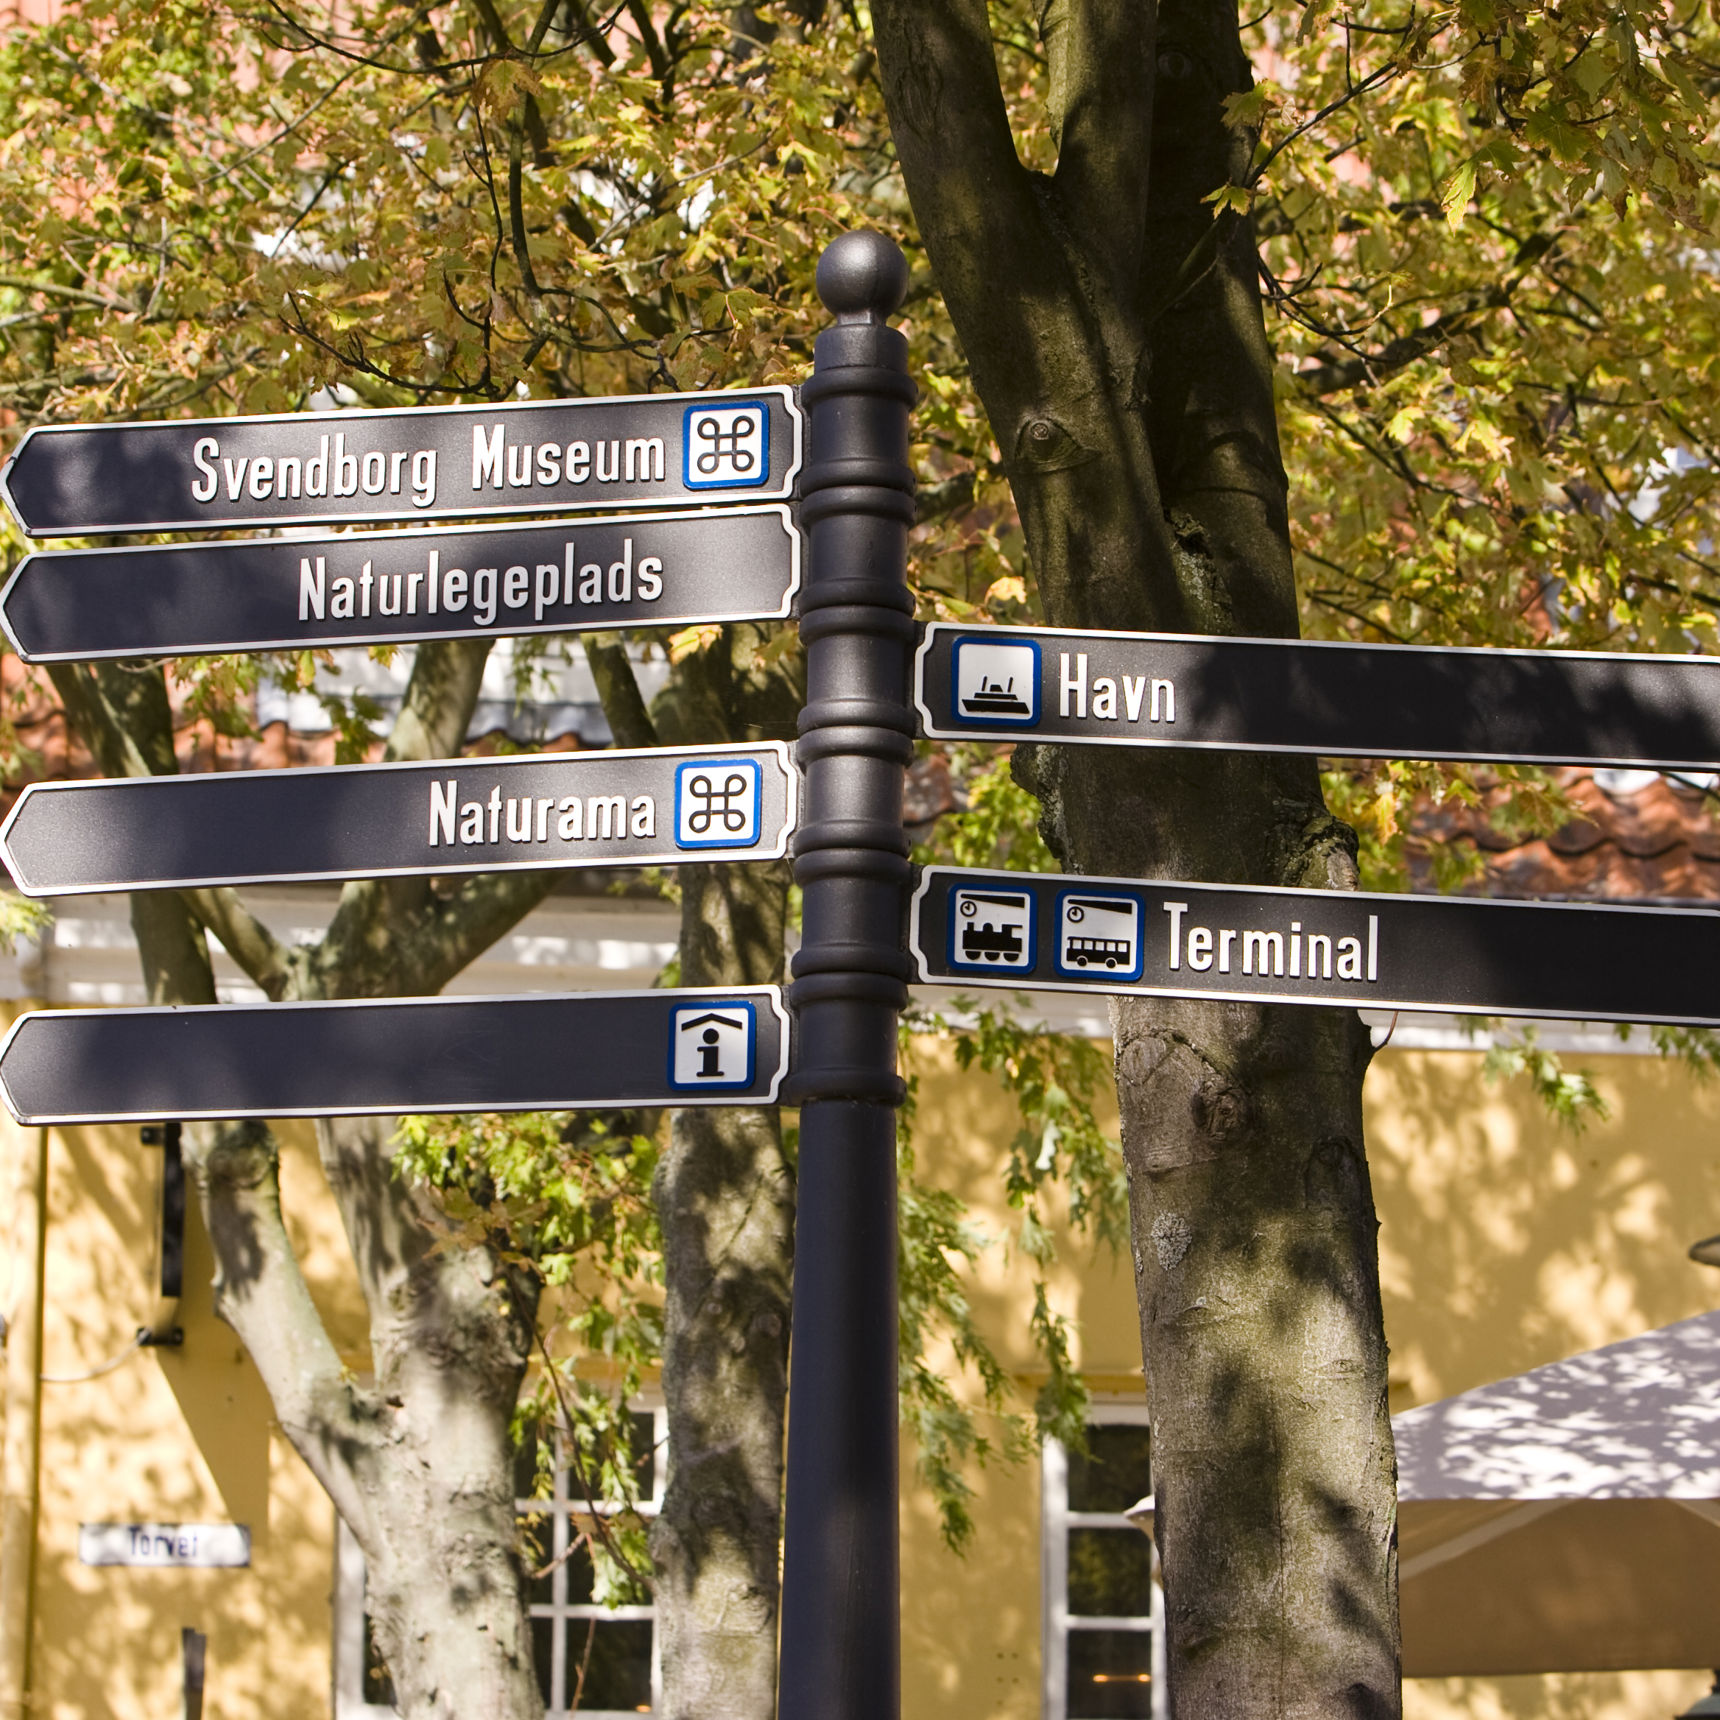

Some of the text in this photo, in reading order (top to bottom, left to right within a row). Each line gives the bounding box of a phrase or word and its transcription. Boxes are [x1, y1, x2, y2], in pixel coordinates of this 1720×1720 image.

[192, 423, 666, 508] Svendborg Museum
[298, 538, 664, 625] Naturlegeplads
[1058, 652, 1176, 723] Havn
[428, 780, 656, 848] Naturama
[1163, 902, 1379, 981] Terminal
[128, 1526, 198, 1558] Torvet
